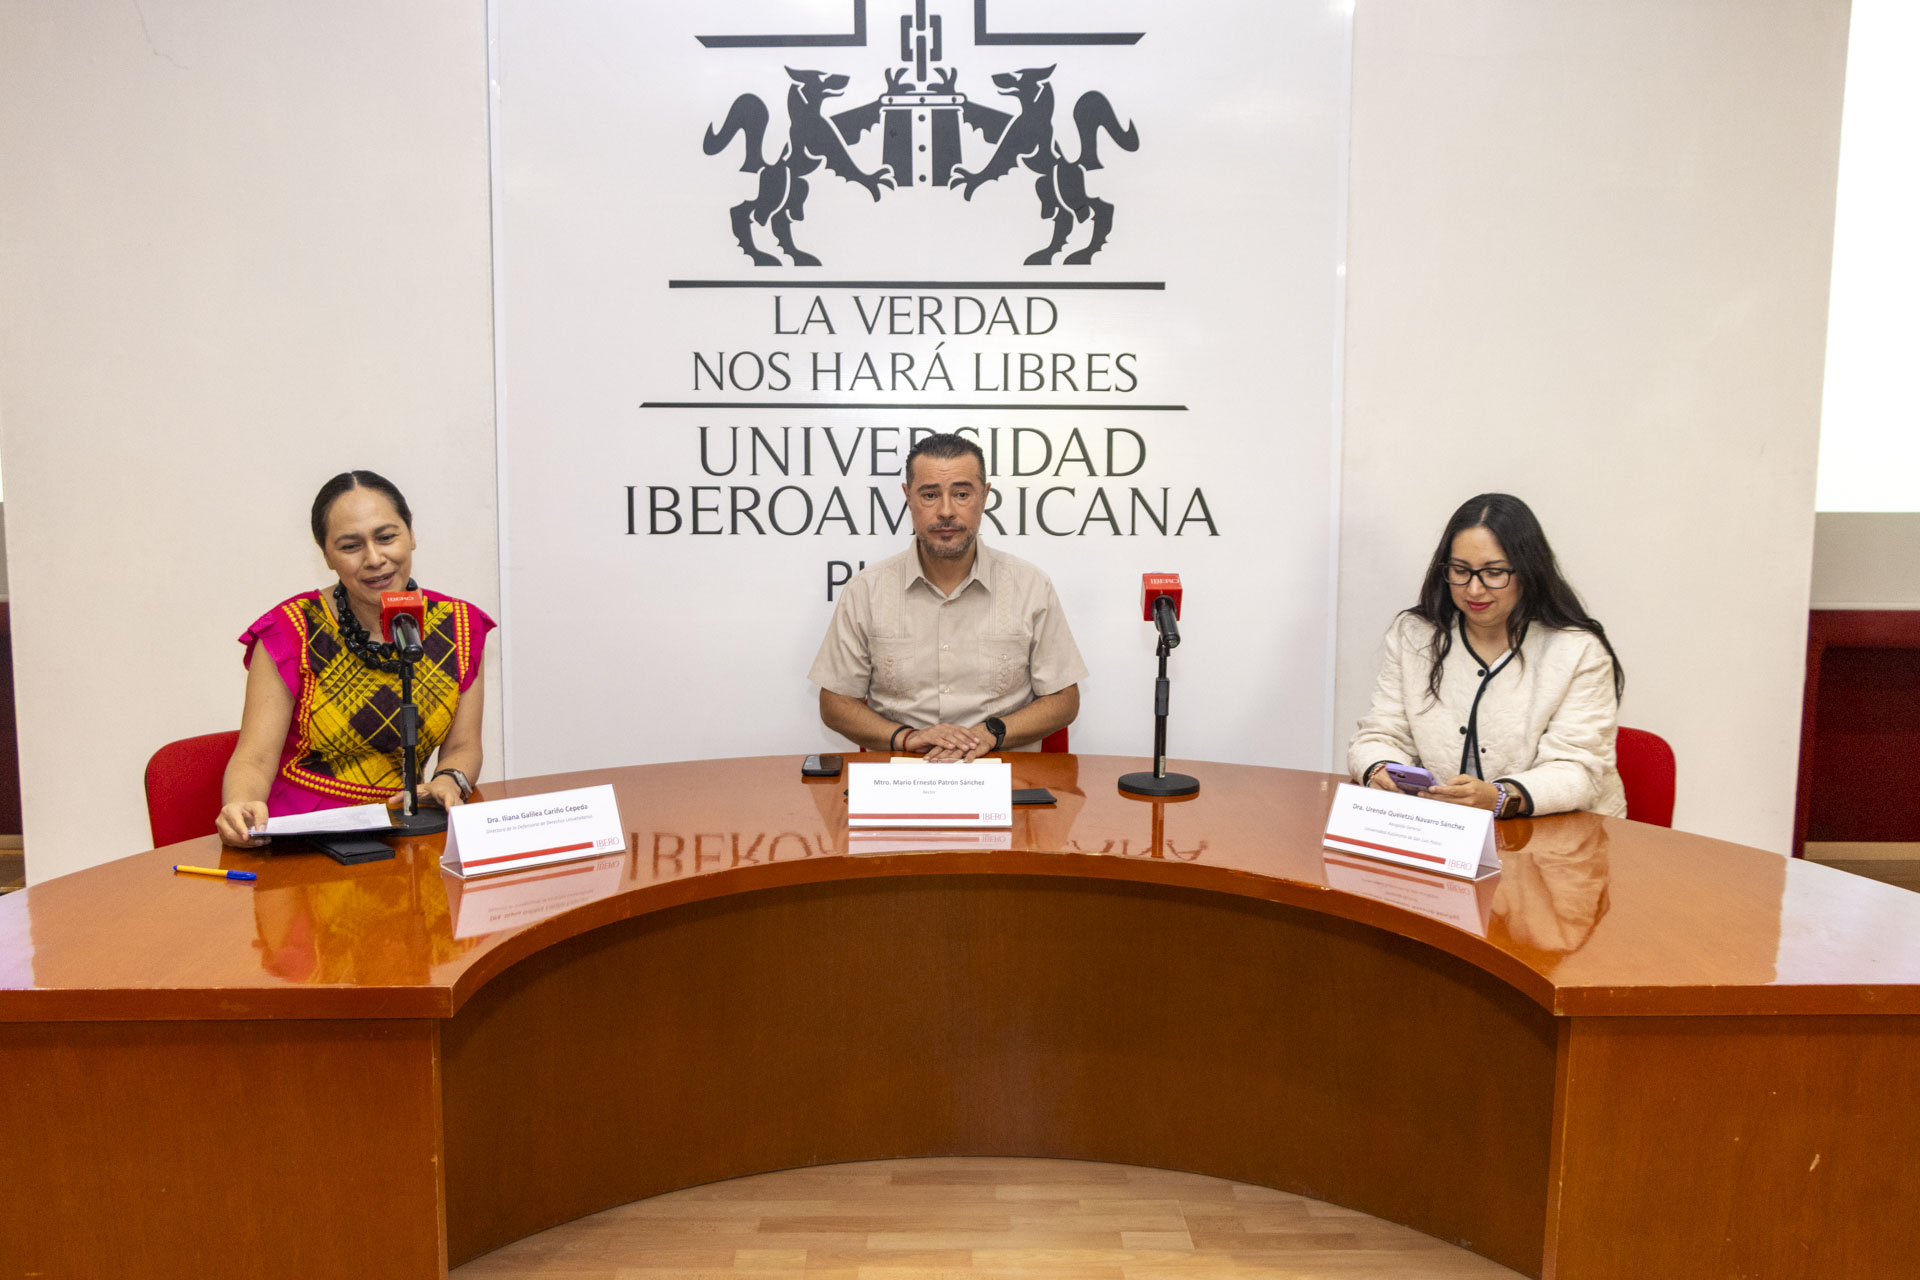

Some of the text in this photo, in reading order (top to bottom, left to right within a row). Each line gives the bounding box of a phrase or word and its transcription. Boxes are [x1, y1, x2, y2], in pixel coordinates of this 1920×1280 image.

[775, 295, 1058, 336] LA VERDAD
[692, 342, 1138, 393] NOS HARÁ LIBRES
[698, 426, 1146, 477] UNIVEIDAD
[625, 485, 1220, 537] IBEROAMRICANA
[521, 810, 542, 819] Galilea
[544, 806, 564, 816] Cariño
[566, 804, 588, 814] Cepeda
[982, 812, 1006, 820] IBERO
[1352, 804, 1364, 812] Dra.
[1416, 815, 1439, 826] Navarro
[1440, 818, 1466, 831] Sánchez
[596, 837, 620, 848] IBERO
[1448, 858, 1472, 870] IBERO
